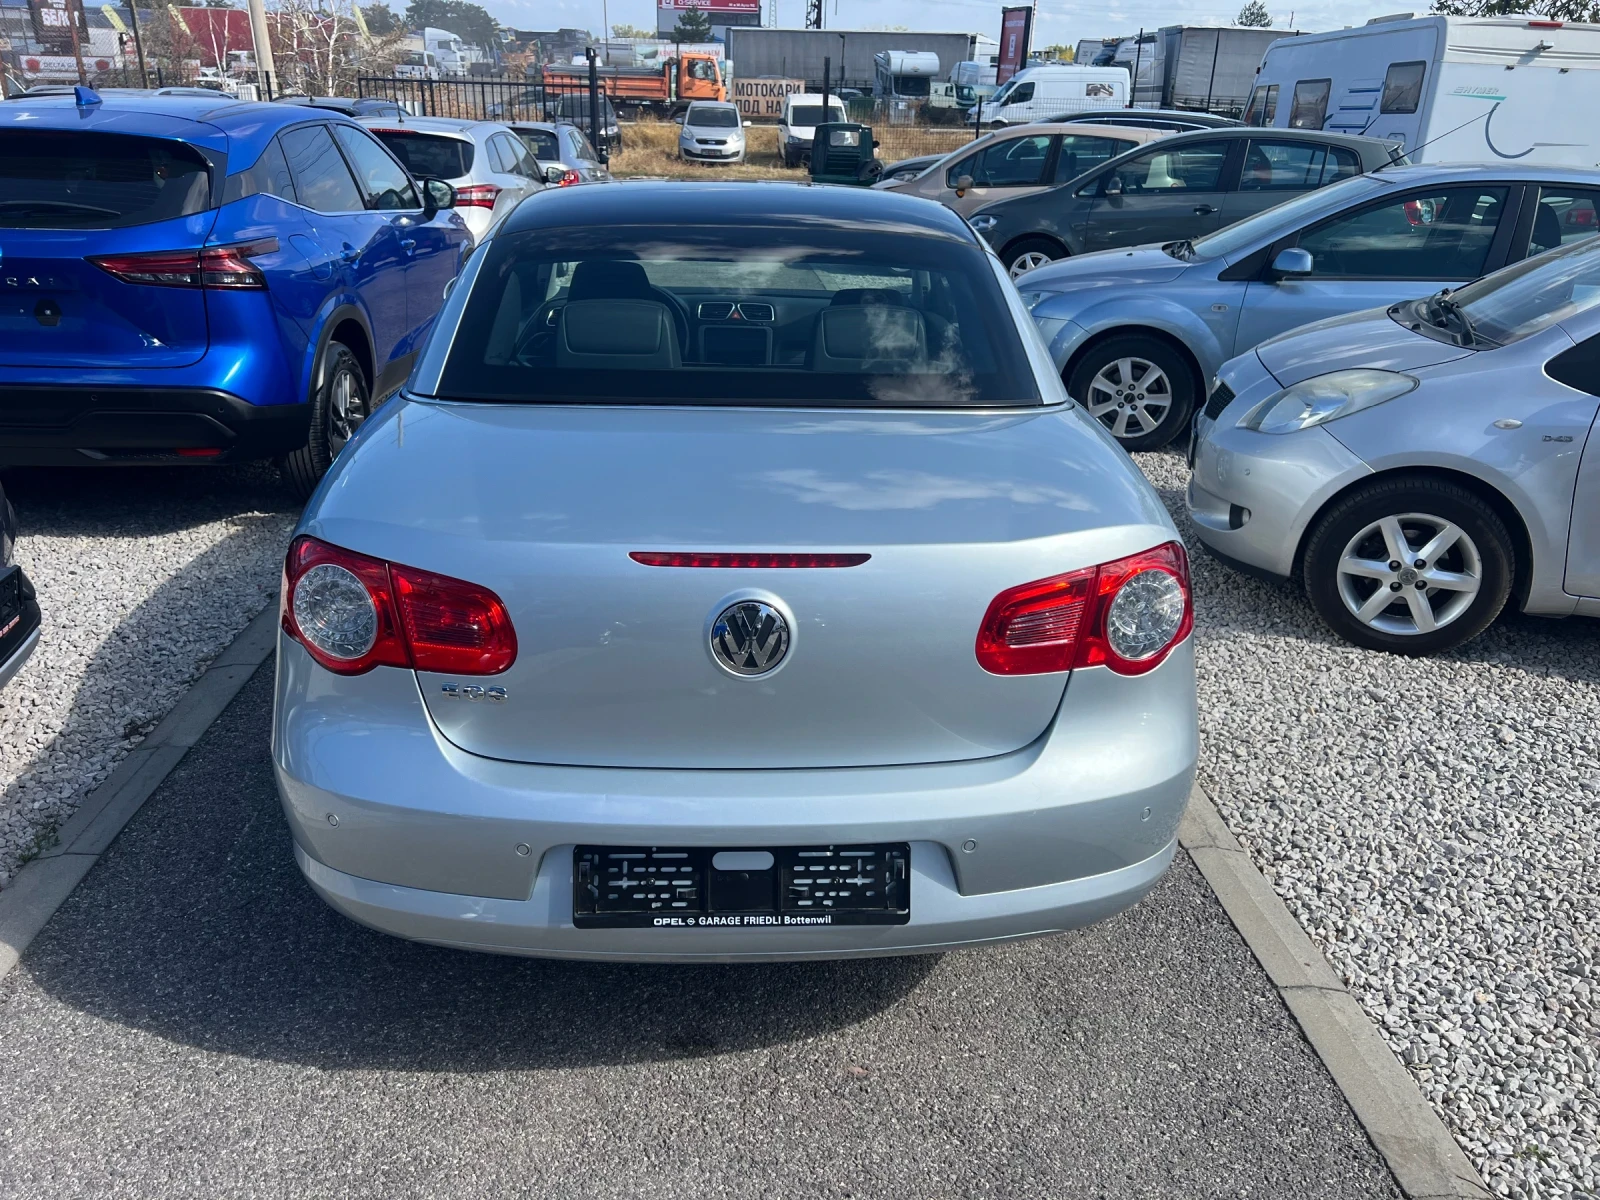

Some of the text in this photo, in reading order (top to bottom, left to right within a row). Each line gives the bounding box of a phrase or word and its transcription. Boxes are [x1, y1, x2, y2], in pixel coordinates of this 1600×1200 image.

[735, 83, 801, 97] МОТОКАРИ
[1463, 86, 1500, 95] HYMER
[735, 99, 782, 115] ПОД НА
[441, 682, 508, 704] EOS
[653, 915, 832, 926] OPEL GARAGE FRIEDLI Bottenwil
